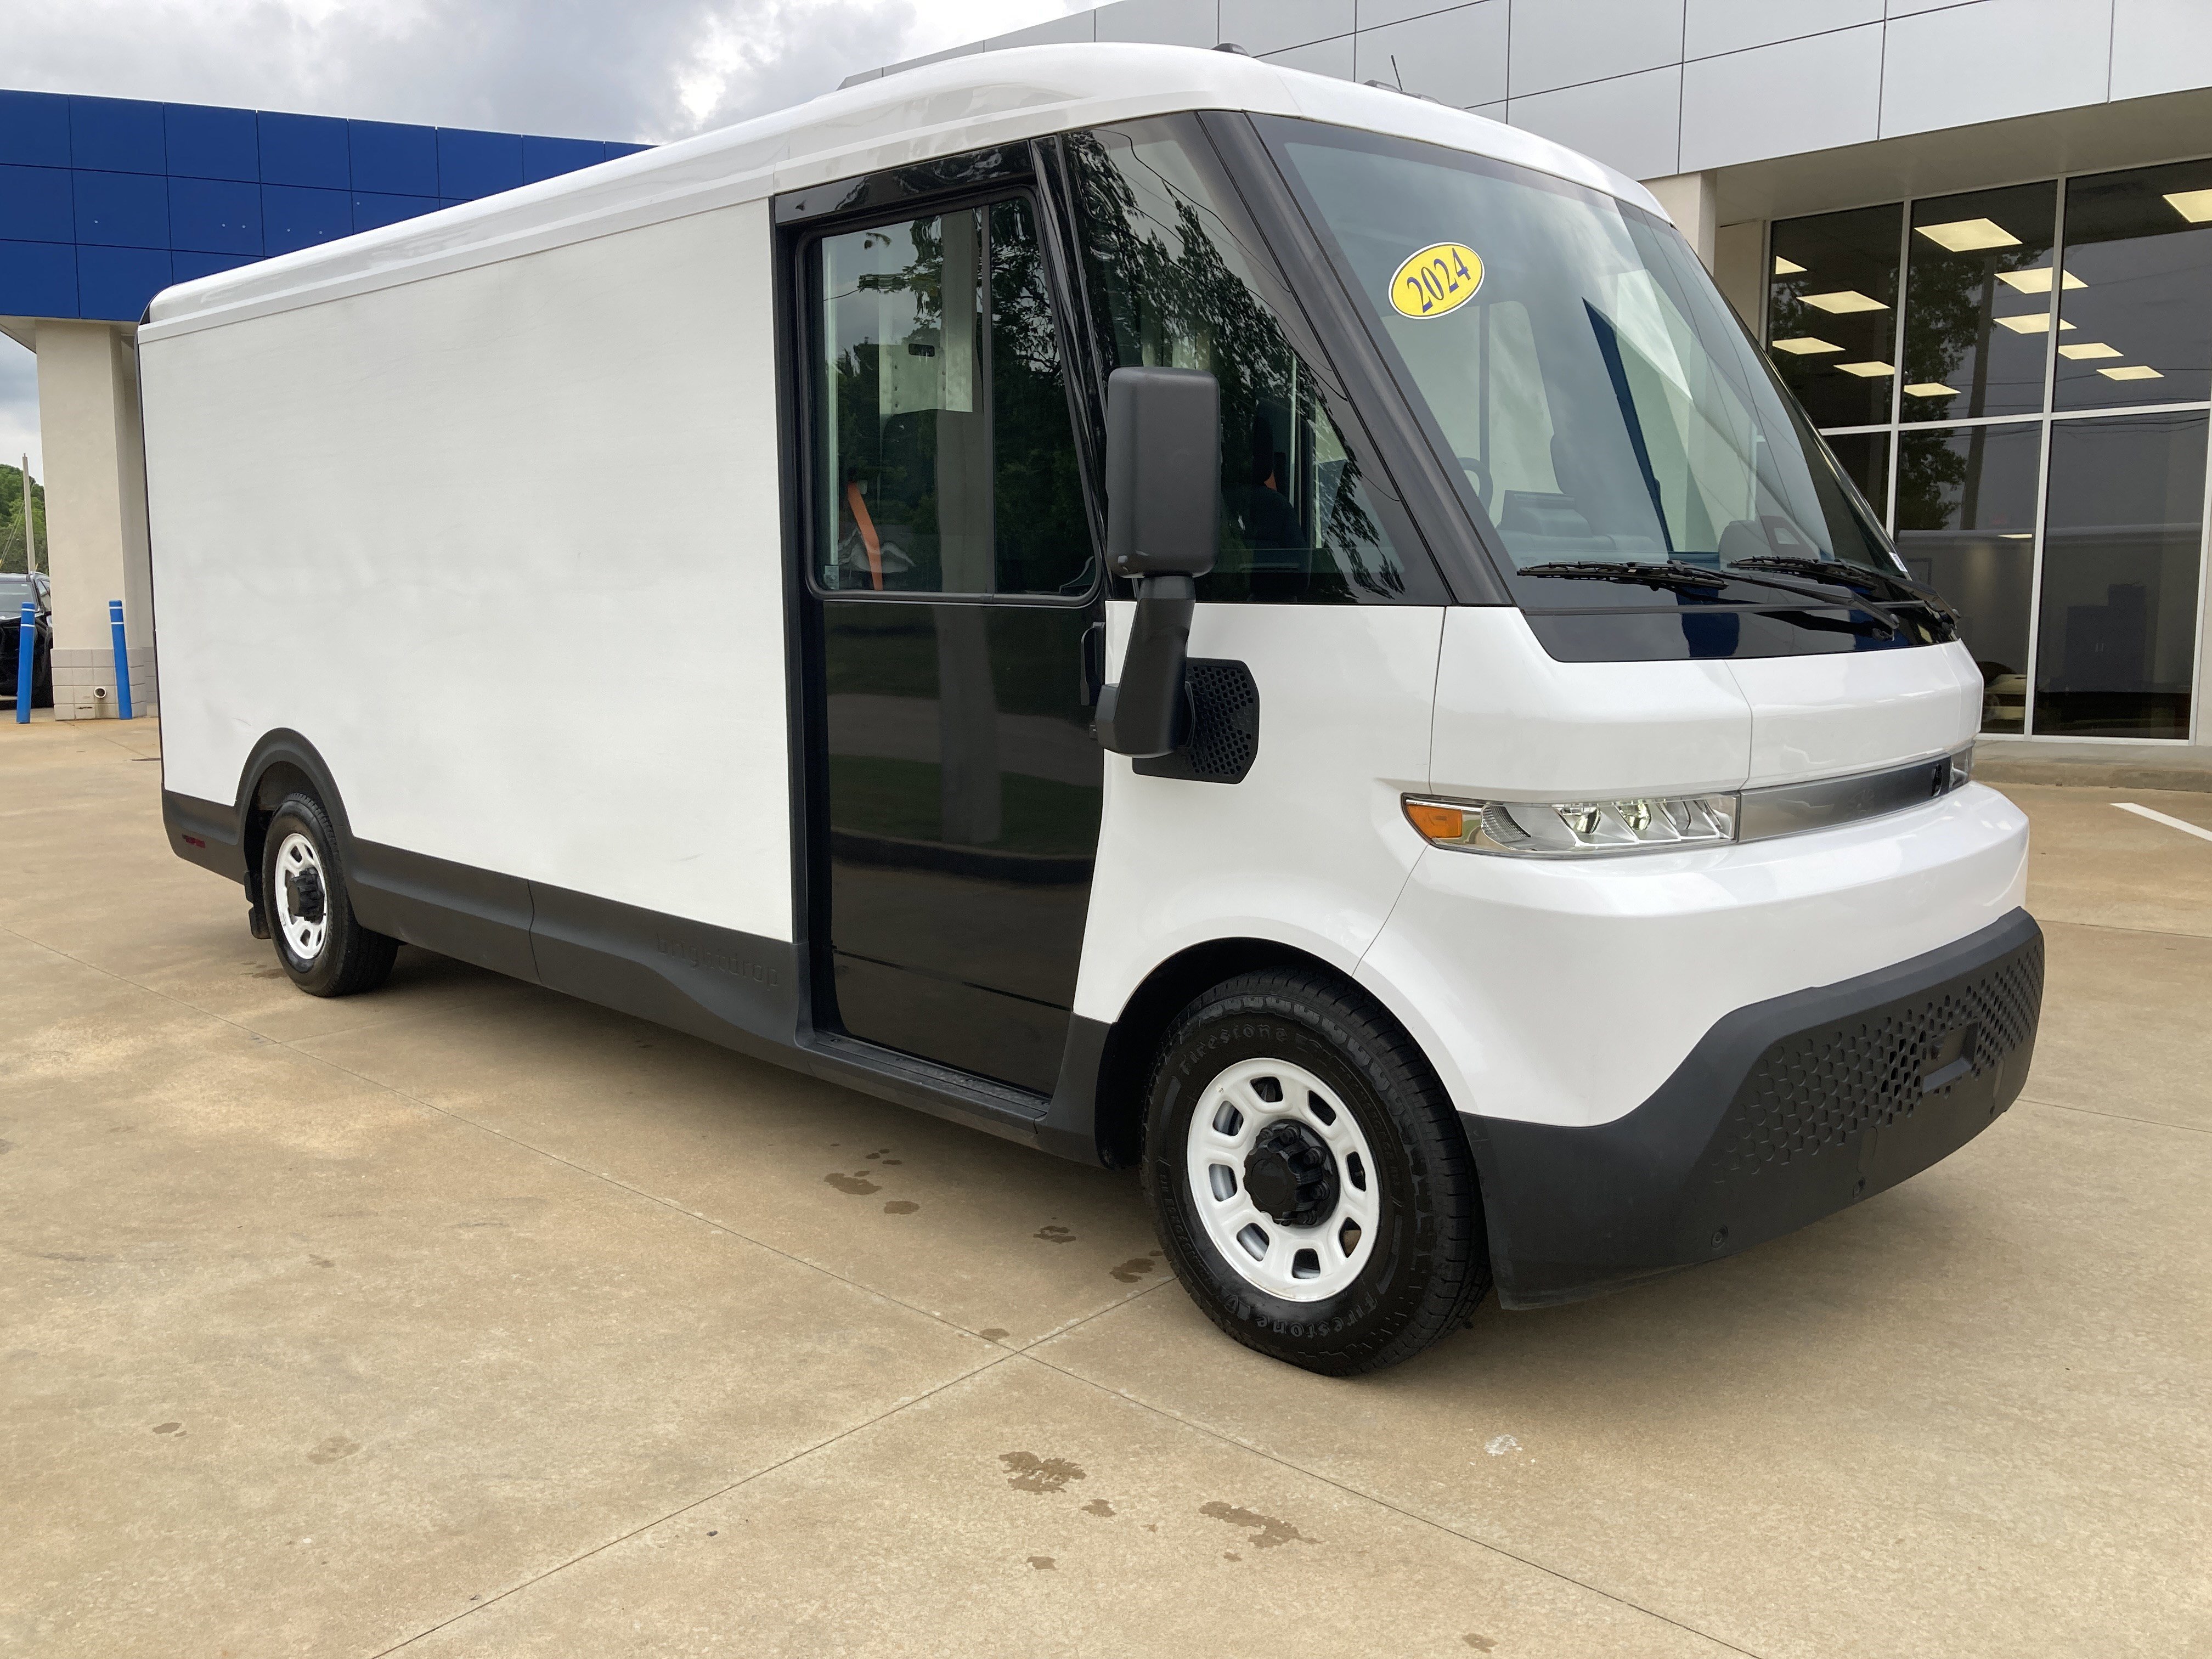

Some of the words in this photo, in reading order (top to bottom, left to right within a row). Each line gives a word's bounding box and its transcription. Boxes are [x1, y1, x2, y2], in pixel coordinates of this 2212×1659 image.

[1407, 247, 1471, 313] 2024
[1179, 1024, 1288, 1076] Firestone
[1255, 1291, 1378, 1338] Firestone
